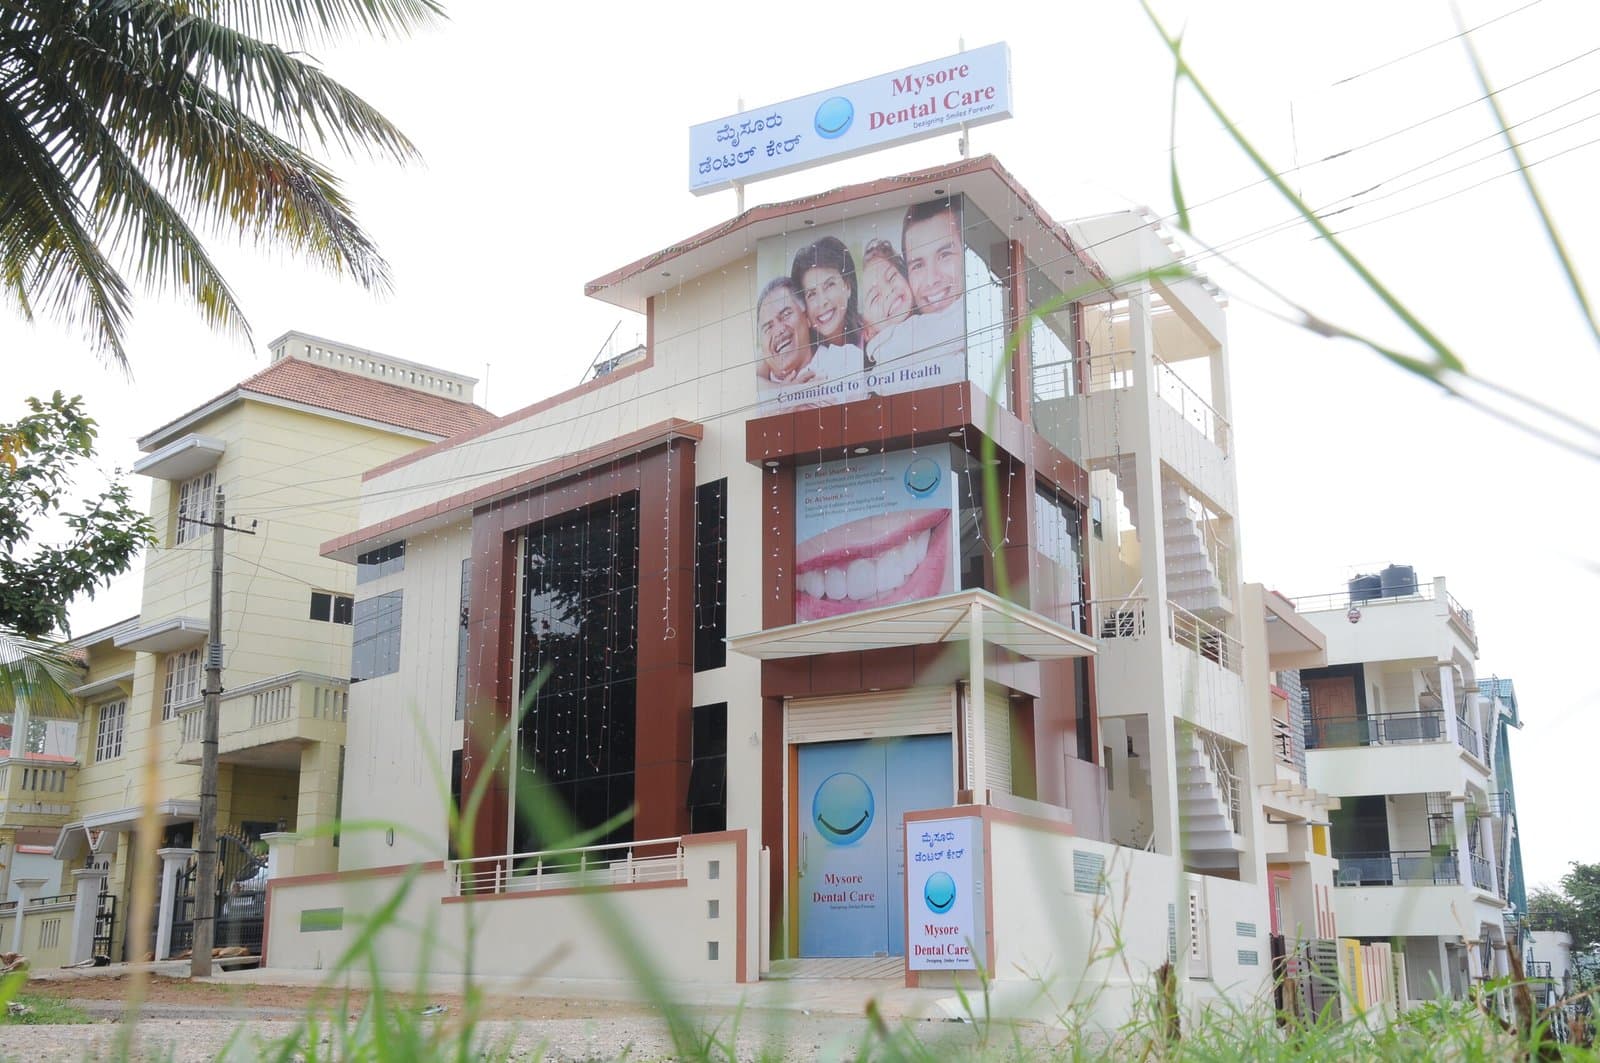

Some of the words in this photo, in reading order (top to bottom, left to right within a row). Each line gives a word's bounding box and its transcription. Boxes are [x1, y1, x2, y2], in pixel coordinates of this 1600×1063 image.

[891, 64, 969, 96] Mysore
[869, 96, 937, 130] Dental
[943, 86, 995, 110] Care
[913, 116, 944, 129] Designing
[946, 109, 967, 121] Smiles
[968, 103, 995, 115] Forever
[716, 112, 782, 147] ಮೈಸೂರು
[699, 146, 757, 174] ಡೆಂಟಲ್
[766, 134, 802, 157] ಕೇರ್
[777, 381, 844, 404] Committed
[847, 380, 860, 392] to
[866, 371, 895, 387] Oral
[899, 364, 942, 383] Health
[824, 873, 863, 887] Mysore
[813, 891, 846, 903] Dental
[849, 890, 875, 902] Care
[924, 924, 959, 939] Mysore
[914, 943, 944, 956] Dental
[947, 943, 970, 956] Care
